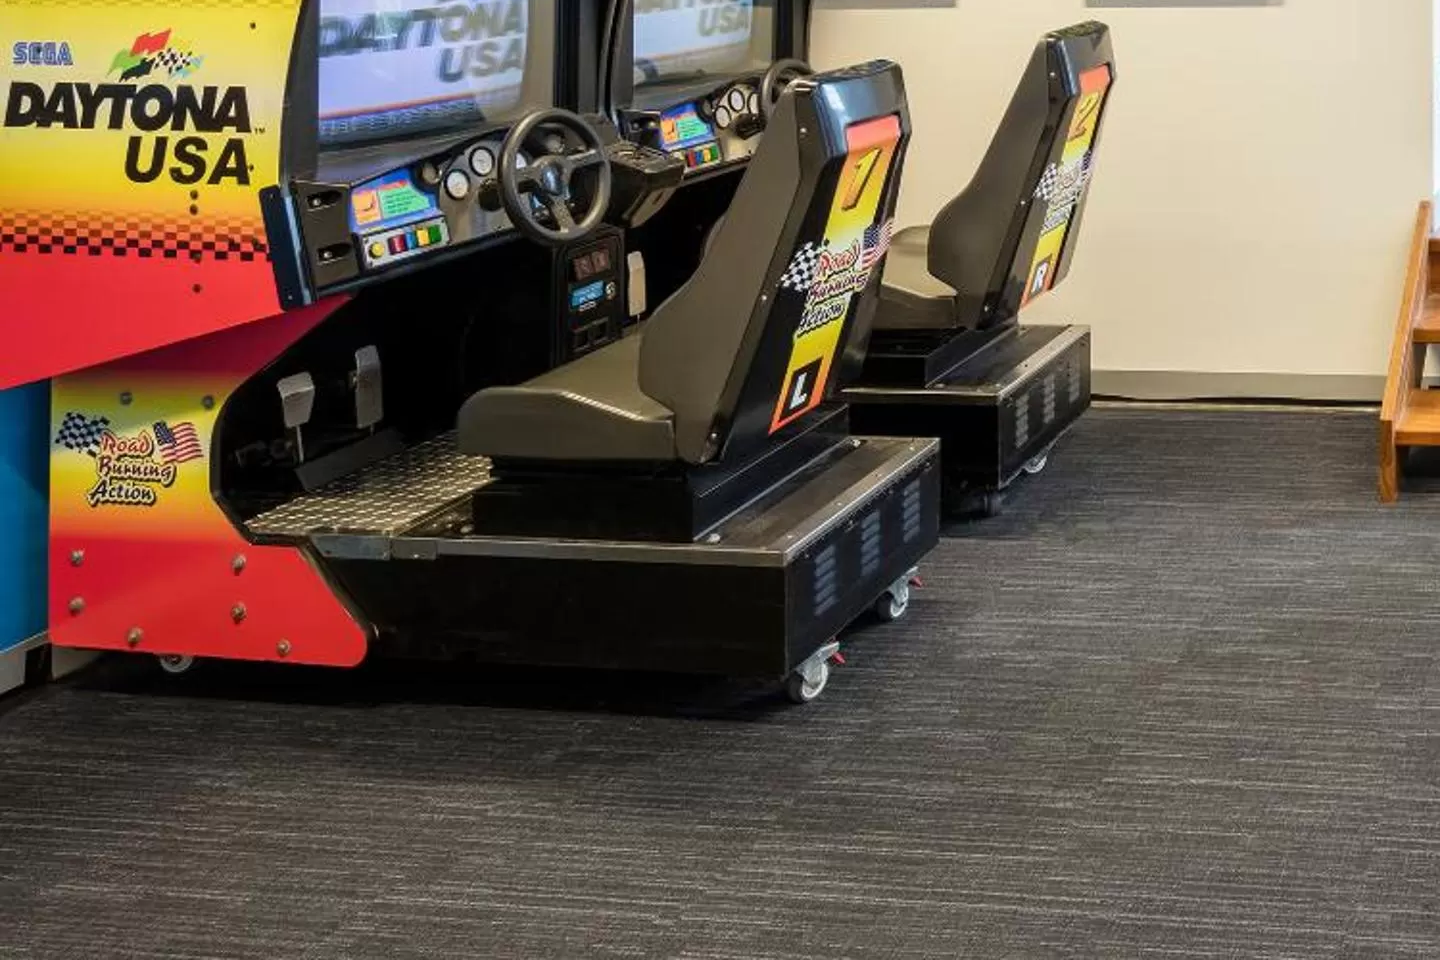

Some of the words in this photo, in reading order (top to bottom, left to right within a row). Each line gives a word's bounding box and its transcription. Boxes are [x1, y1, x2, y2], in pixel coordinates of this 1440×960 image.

[698, 3, 750, 37] USA
[12, 41, 74, 66] SEGA
[436, 37, 526, 83] USA
[4, 81, 252, 134] DAYTONA
[124, 135, 252, 186] USA
[788, 372, 809, 410] L
[100, 429, 154, 455] Road
[98, 454, 176, 484] Burning
[88, 478, 156, 506] Action
